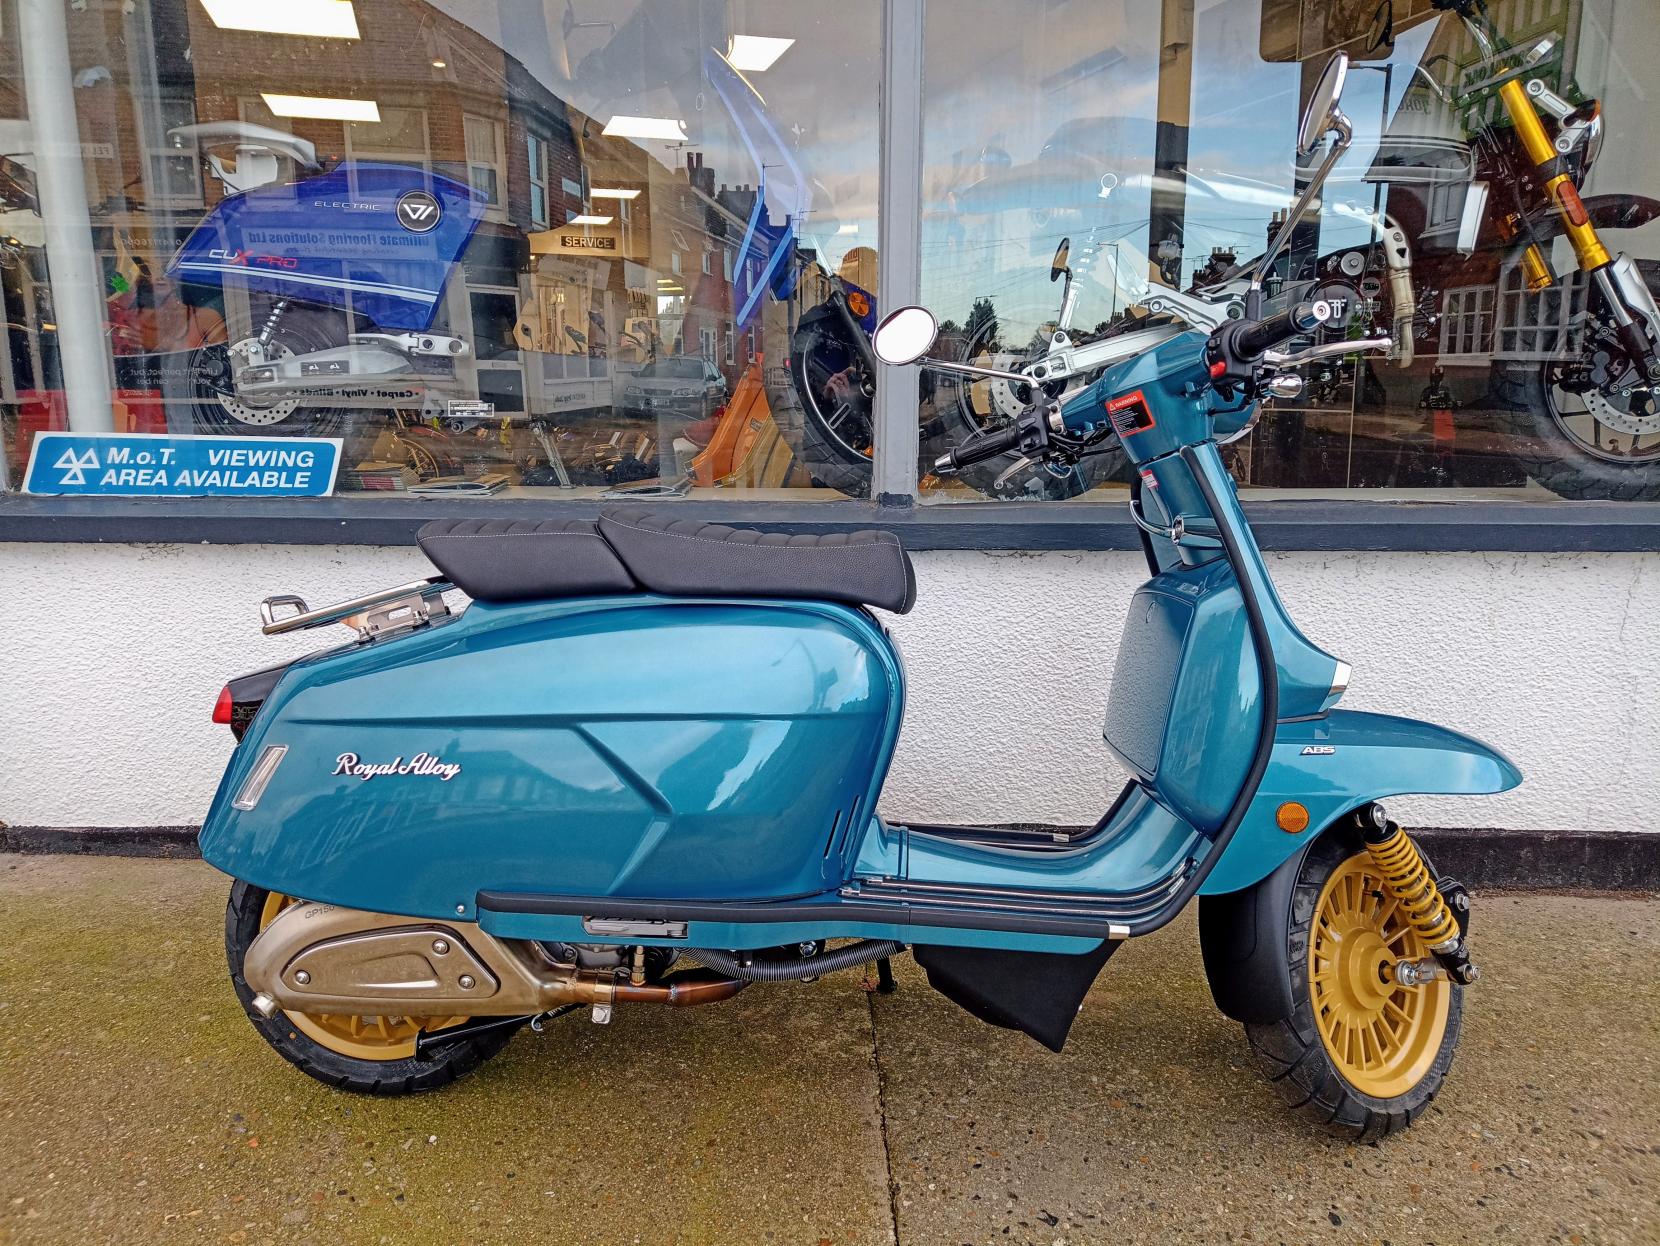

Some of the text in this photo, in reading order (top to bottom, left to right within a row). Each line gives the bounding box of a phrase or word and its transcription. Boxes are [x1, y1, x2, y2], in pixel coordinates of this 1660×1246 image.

[314, 200, 381, 211] ELECTRIC
[565, 237, 611, 248] SERVICE
[107, 447, 314, 468] M.o.T. VIEWING
[100, 469, 312, 488] AREA AVAILABLE
[1302, 745, 1336, 755] ABS
[331, 752, 461, 781] Royal Alloy
